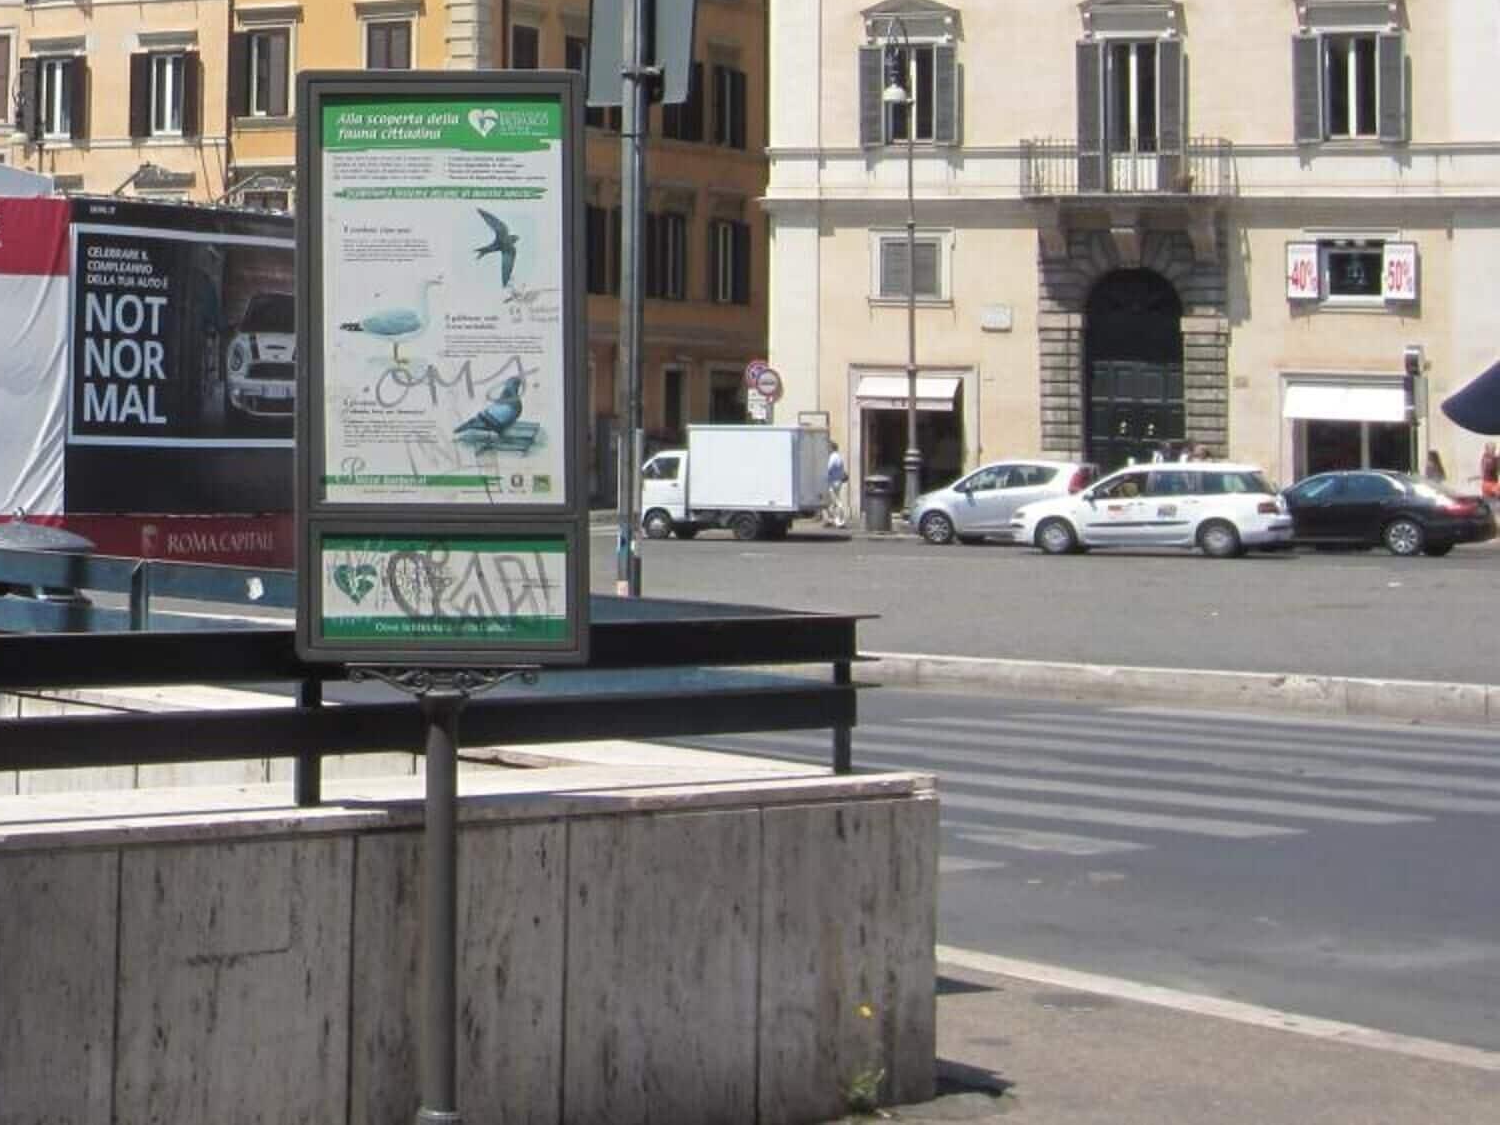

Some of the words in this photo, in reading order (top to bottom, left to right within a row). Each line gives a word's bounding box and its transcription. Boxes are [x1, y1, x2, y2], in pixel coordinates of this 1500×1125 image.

[338, 112, 363, 125] Alla
[366, 112, 423, 126] scoperta
[427, 112, 459, 125] della
[337, 126, 377, 142] fauna
[381, 125, 442, 140] cittadina
[86, 246, 140, 260] CELEBRARE
[86, 260, 154, 275] COMPLEANNO
[86, 274, 116, 285] DELLA
[85, 292, 168, 335] NOT
[84, 338, 167, 380] NOR
[83, 382, 168, 425] MAL
[167, 530, 218, 555] ROMA
